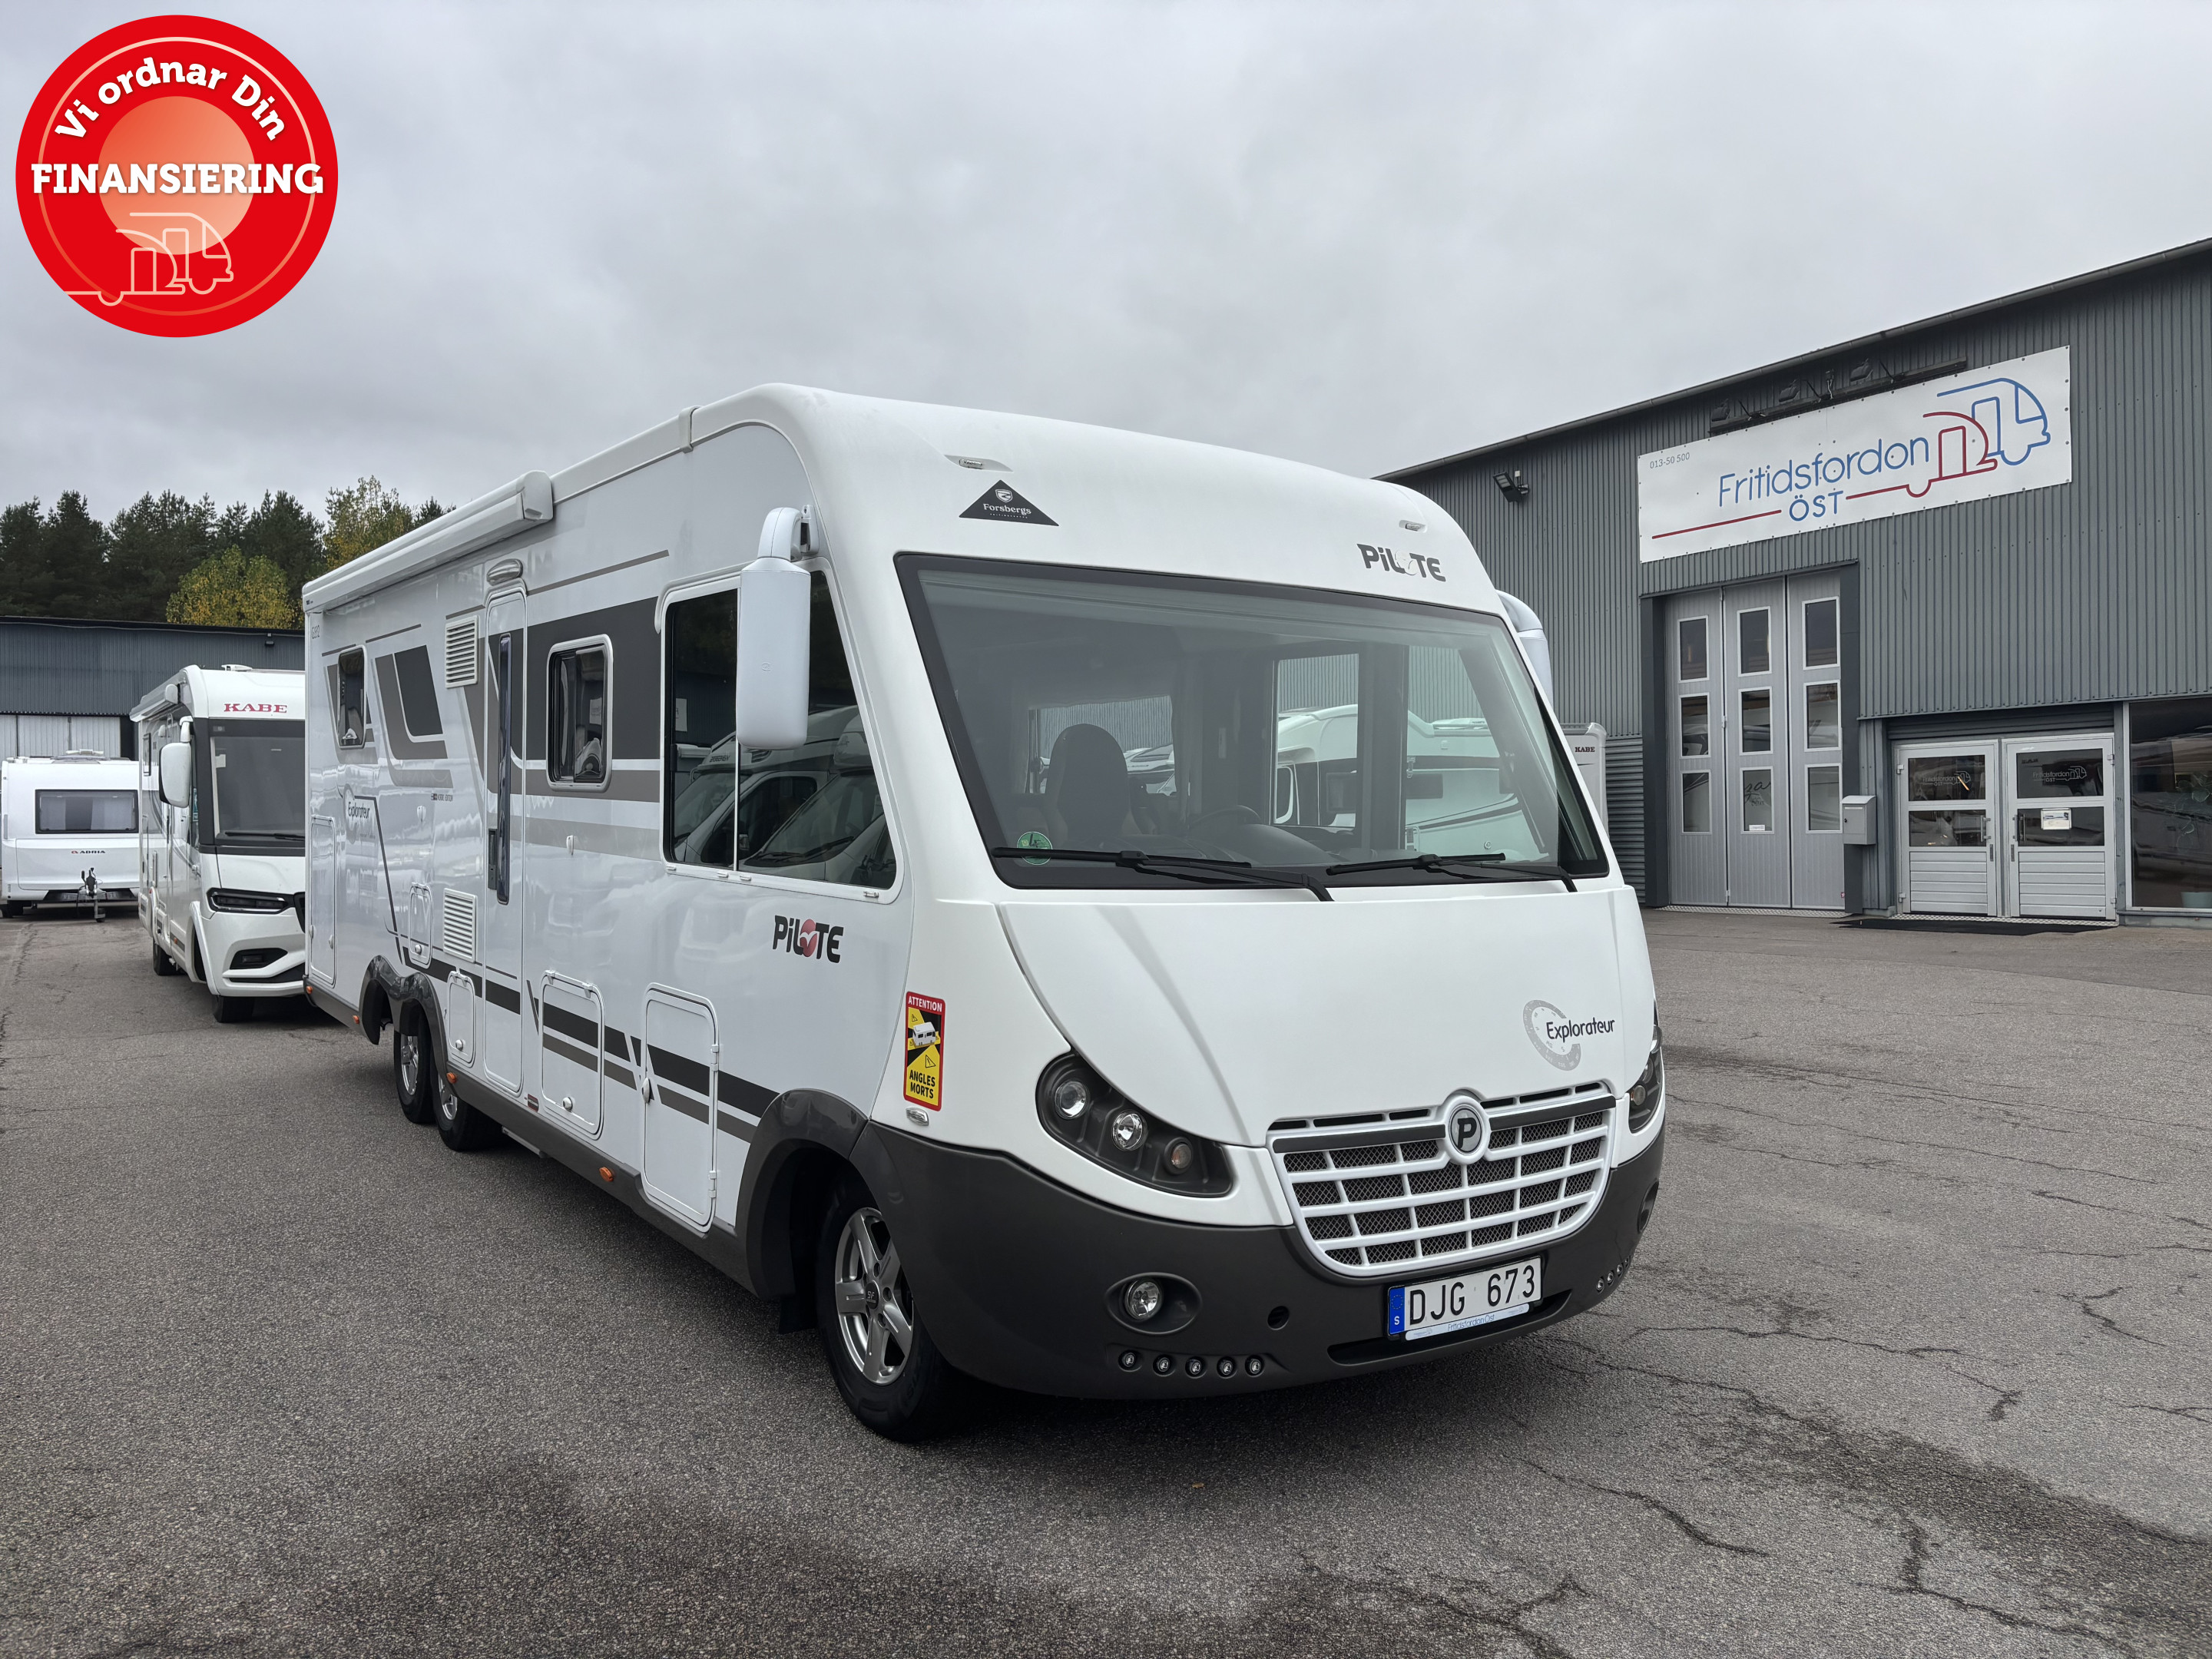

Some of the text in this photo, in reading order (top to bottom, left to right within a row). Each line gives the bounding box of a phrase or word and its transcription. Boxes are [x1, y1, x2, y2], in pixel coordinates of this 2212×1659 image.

[1650, 452, 1690, 469] 013-50 500
[1719, 436, 1929, 508] Fritidsfordon
[983, 503, 1031, 516] Forsbergs
[1788, 490, 1844, 522] ÖST
[224, 703, 288, 714] KABE
[348, 801, 371, 819] Explorateur
[908, 995, 942, 1012] ATTENTION
[1546, 1016, 1615, 1043] Explorateur
[909, 1069, 935, 1088] ANGLES
[910, 1081, 934, 1099] MORTS
[1457, 1117, 1477, 1149] P
[1409, 1264, 1535, 1326] DJG 673
[1394, 1316, 1400, 1326] S
